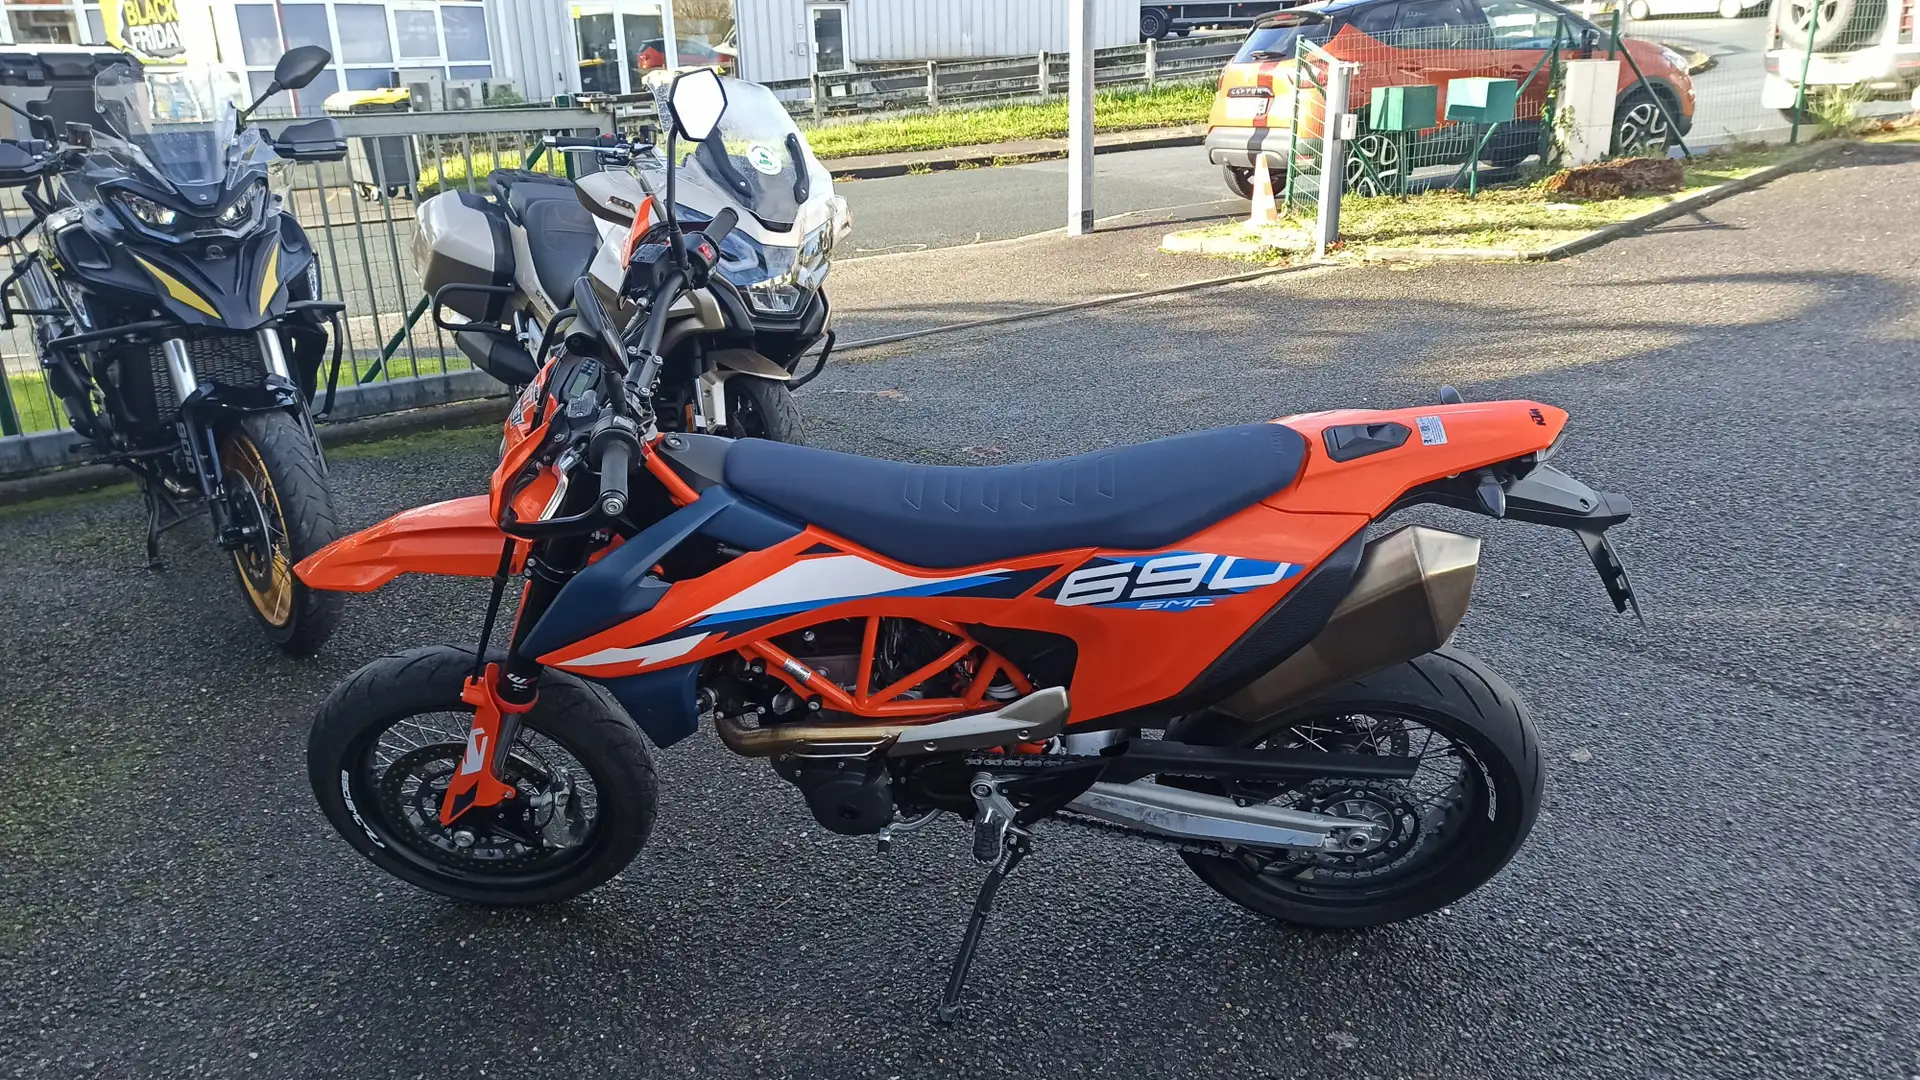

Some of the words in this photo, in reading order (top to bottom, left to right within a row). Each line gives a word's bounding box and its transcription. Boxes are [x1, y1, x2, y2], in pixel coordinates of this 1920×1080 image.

[123, 0, 179, 26] BLACK
[129, 22, 184, 50] FRIDAY
[1529, 408, 1547, 427] KTM
[1054, 552, 1292, 607] 690
[1136, 598, 1215, 611] SMC
